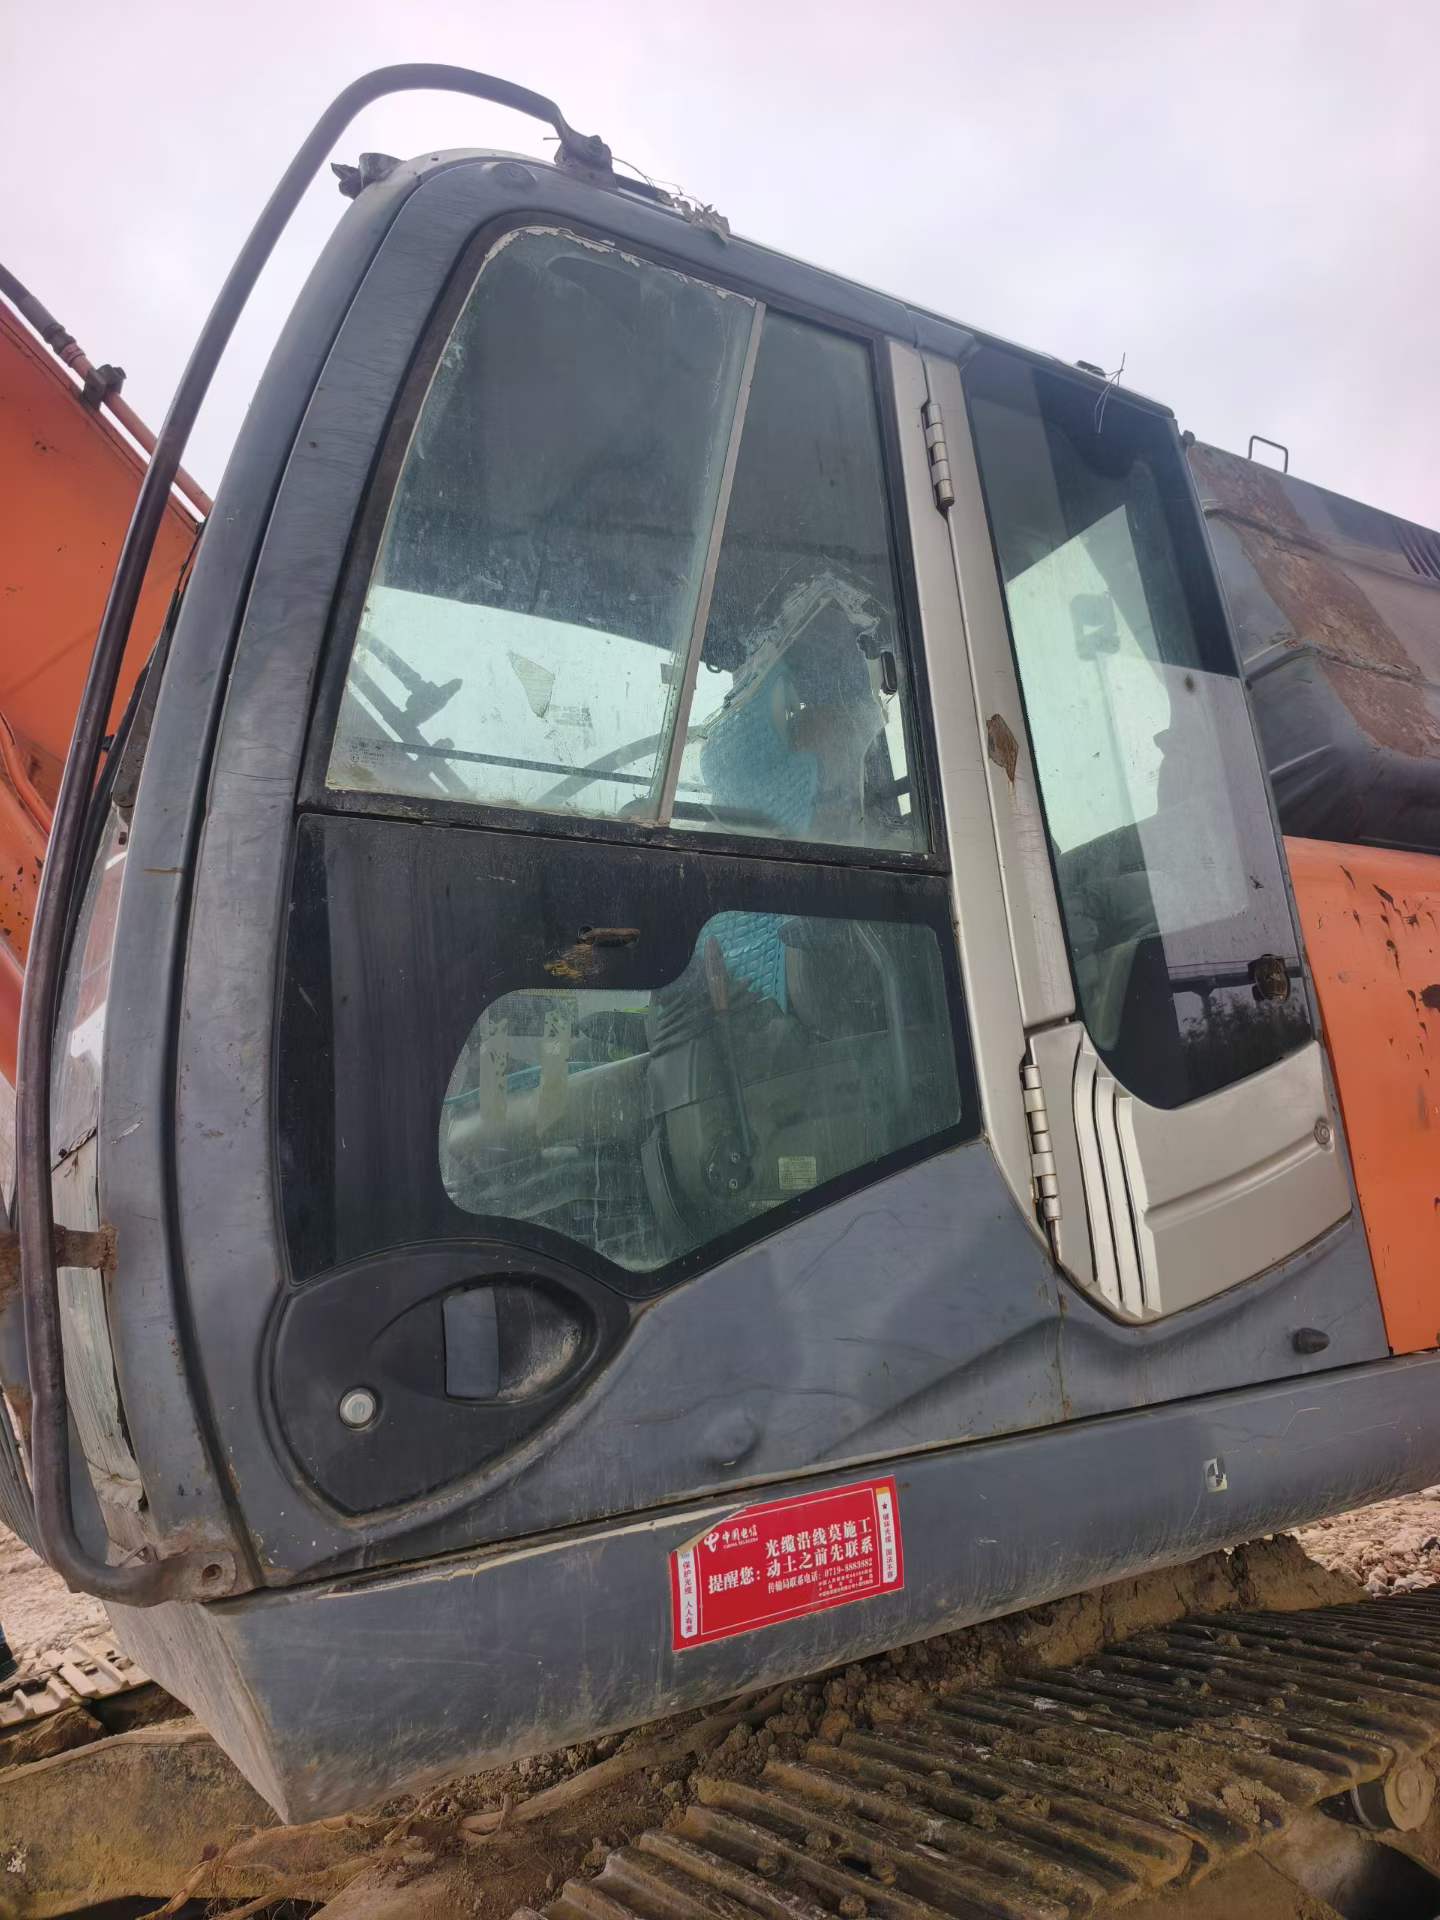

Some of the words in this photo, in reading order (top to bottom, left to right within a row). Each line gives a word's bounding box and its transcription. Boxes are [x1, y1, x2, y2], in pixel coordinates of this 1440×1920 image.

[722, 1523, 757, 1544] 中国电信
[765, 1517, 871, 1559] 光缆沿线莫施工
[766, 1536, 873, 1578] 动土之前先联系
